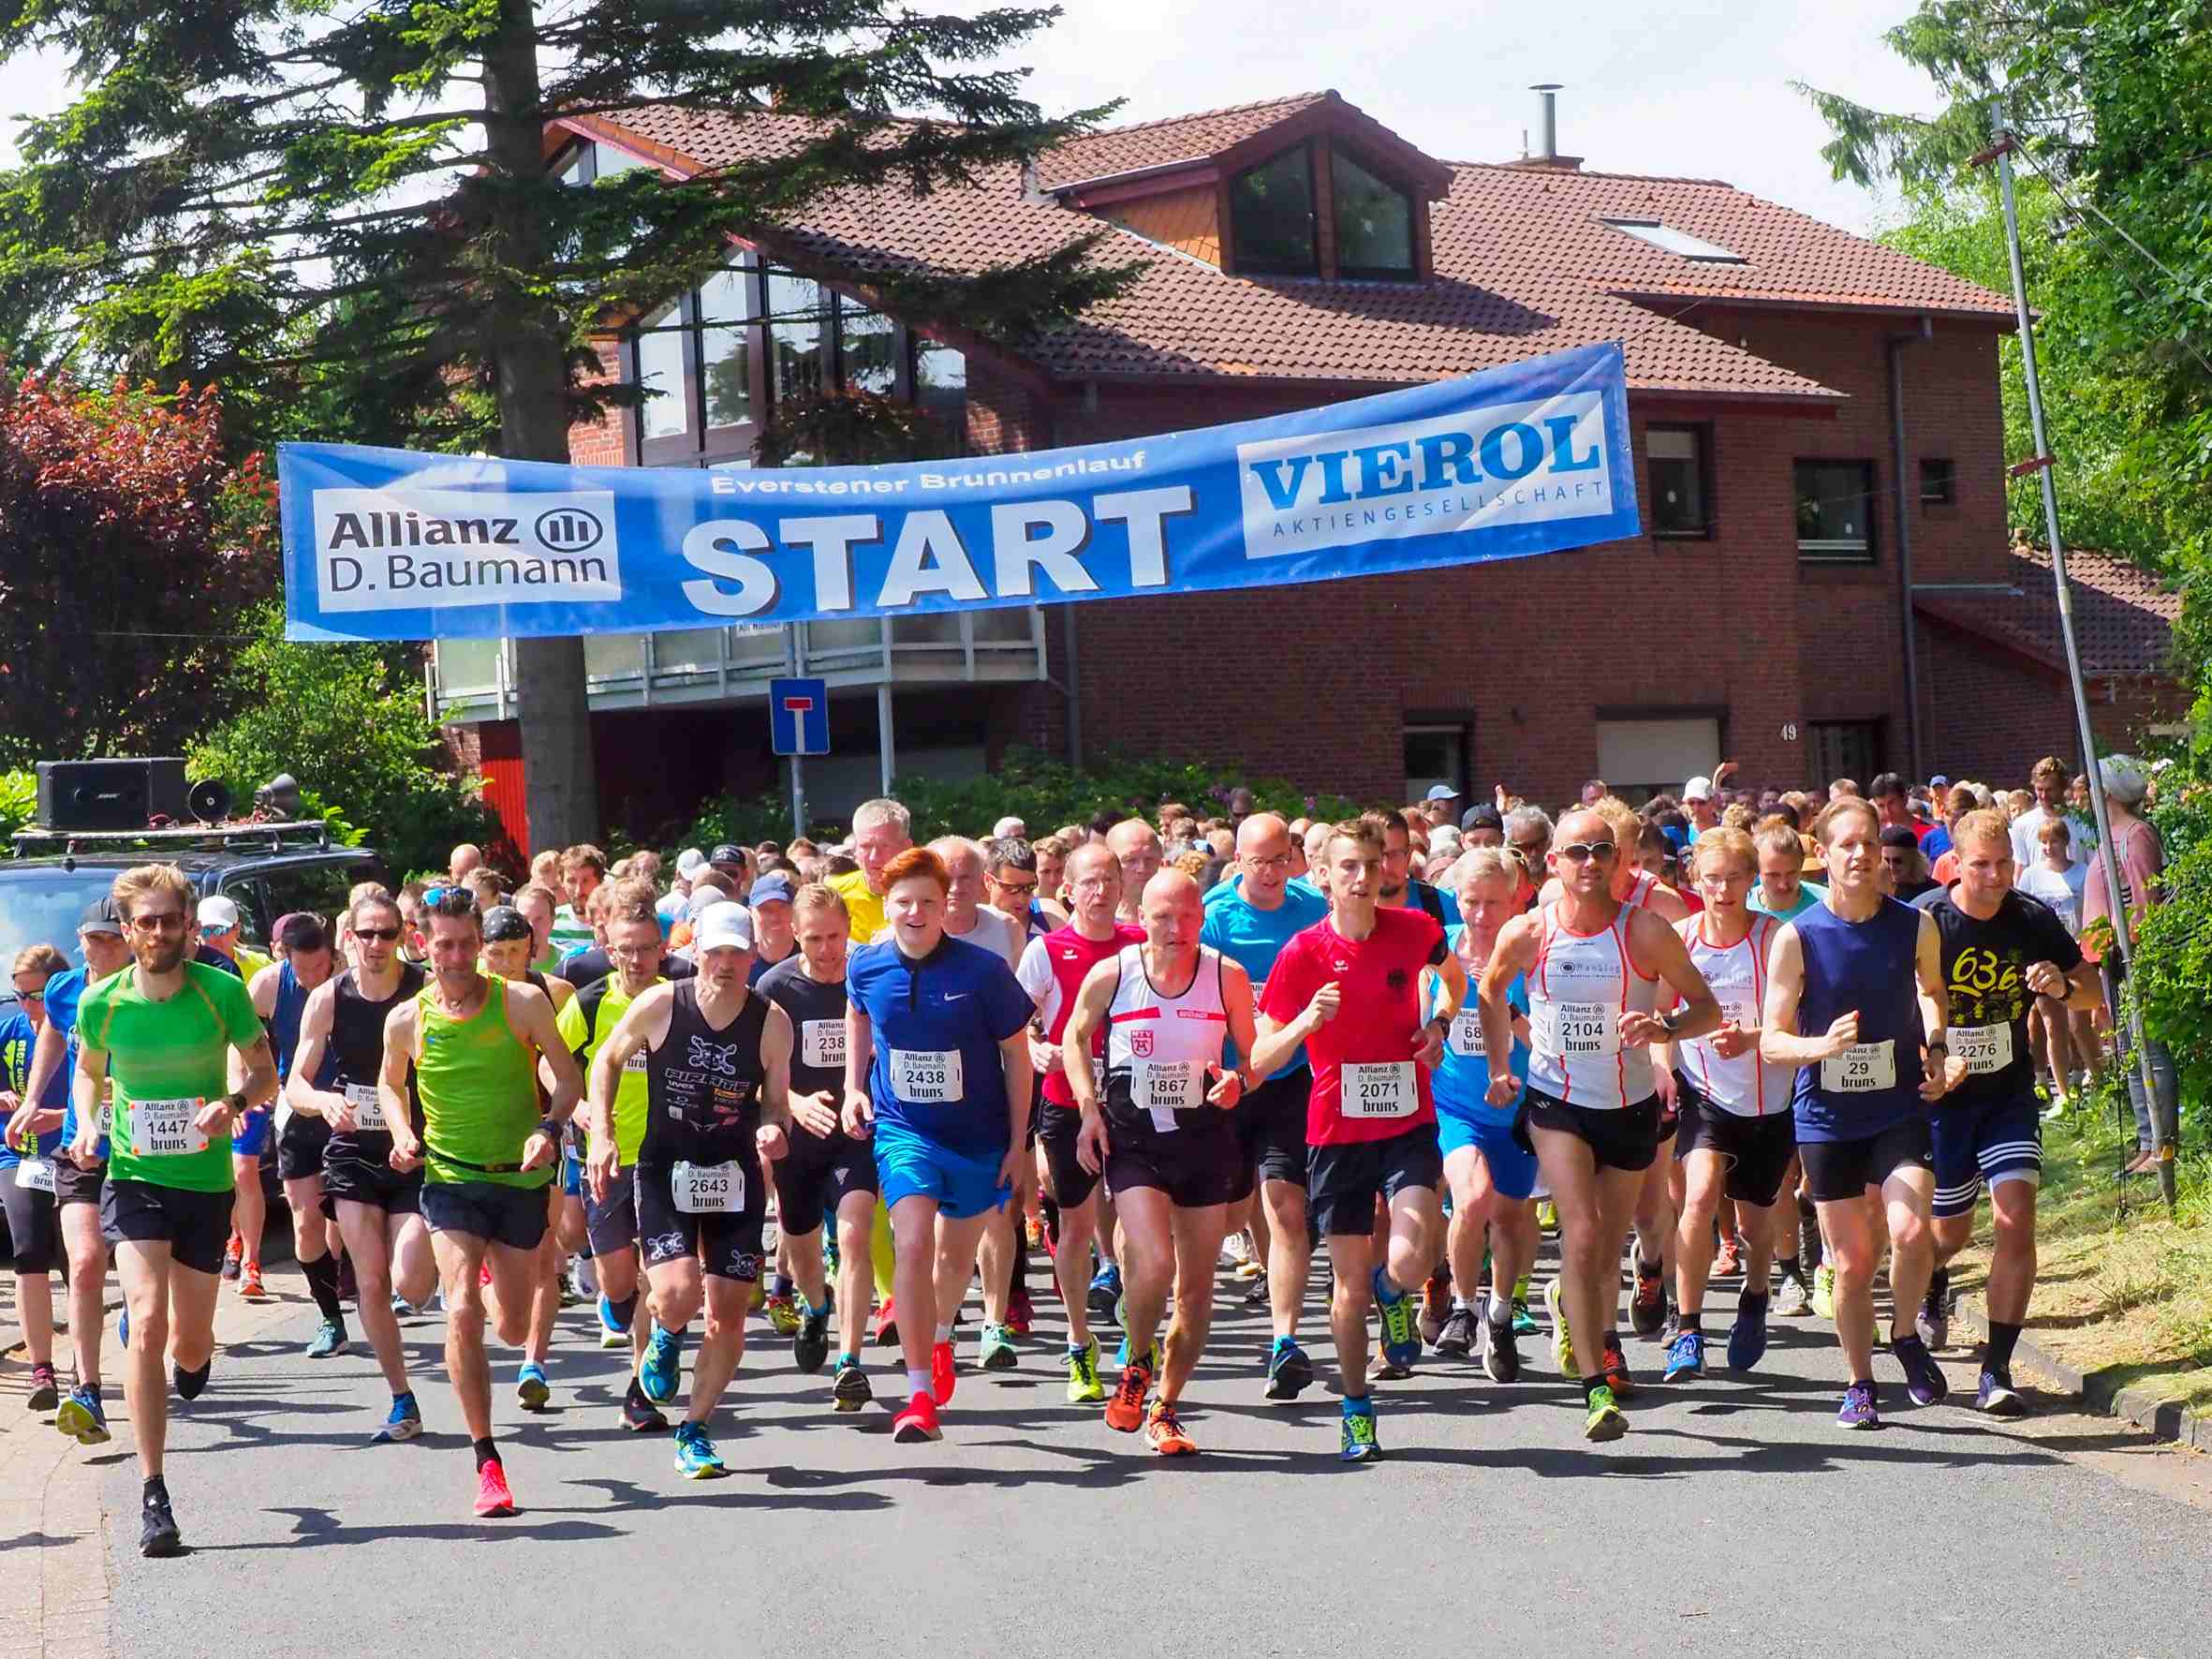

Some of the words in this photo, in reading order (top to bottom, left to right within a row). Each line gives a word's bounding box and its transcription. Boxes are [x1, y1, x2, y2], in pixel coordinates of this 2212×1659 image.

[1249, 414, 1601, 511] VIEROL
[712, 476, 910, 495] Everstener
[921, 450, 1146, 489] Brunnenlauf
[1273, 481, 1604, 538] AKTIENGESELLSCHAFT
[328, 511, 521, 550] Allianz
[681, 484, 1195, 617] START
[329, 556, 376, 593] D.
[388, 554, 607, 590] Baumann
[1780, 724, 1797, 741] 49
[1560, 1004, 1591, 1014] Allianz
[1465, 1026, 1482, 1039] 68
[1561, 1022, 1604, 1037] 2104
[818, 1037, 846, 1050] 238
[1463, 1039, 1485, 1051] bru
[1565, 1037, 1601, 1051] bruns
[821, 1050, 847, 1062] brun
[904, 1053, 933, 1061] Allianz
[1957, 1043, 1997, 1058] 2276
[1147, 1063, 1178, 1072] Allianz
[1358, 1065, 1388, 1074] Allianz
[1849, 1061, 1869, 1074] 29
[906, 1070, 945, 1084] 2438
[1841, 1075, 1877, 1088] bruns
[909, 1084, 944, 1098] bruns
[1148, 1079, 1188, 1092] 1867
[1360, 1082, 1399, 1098] 2071
[1150, 1093, 1185, 1105] bruns
[1363, 1099, 1399, 1112] bruns
[144, 1103, 175, 1111] Allianz
[148, 1119, 188, 1134] 1447
[361, 1115, 387, 1127] brun
[150, 1136, 187, 1150] bruns
[689, 1178, 729, 1192] 2643
[692, 1194, 725, 1207] bruns
